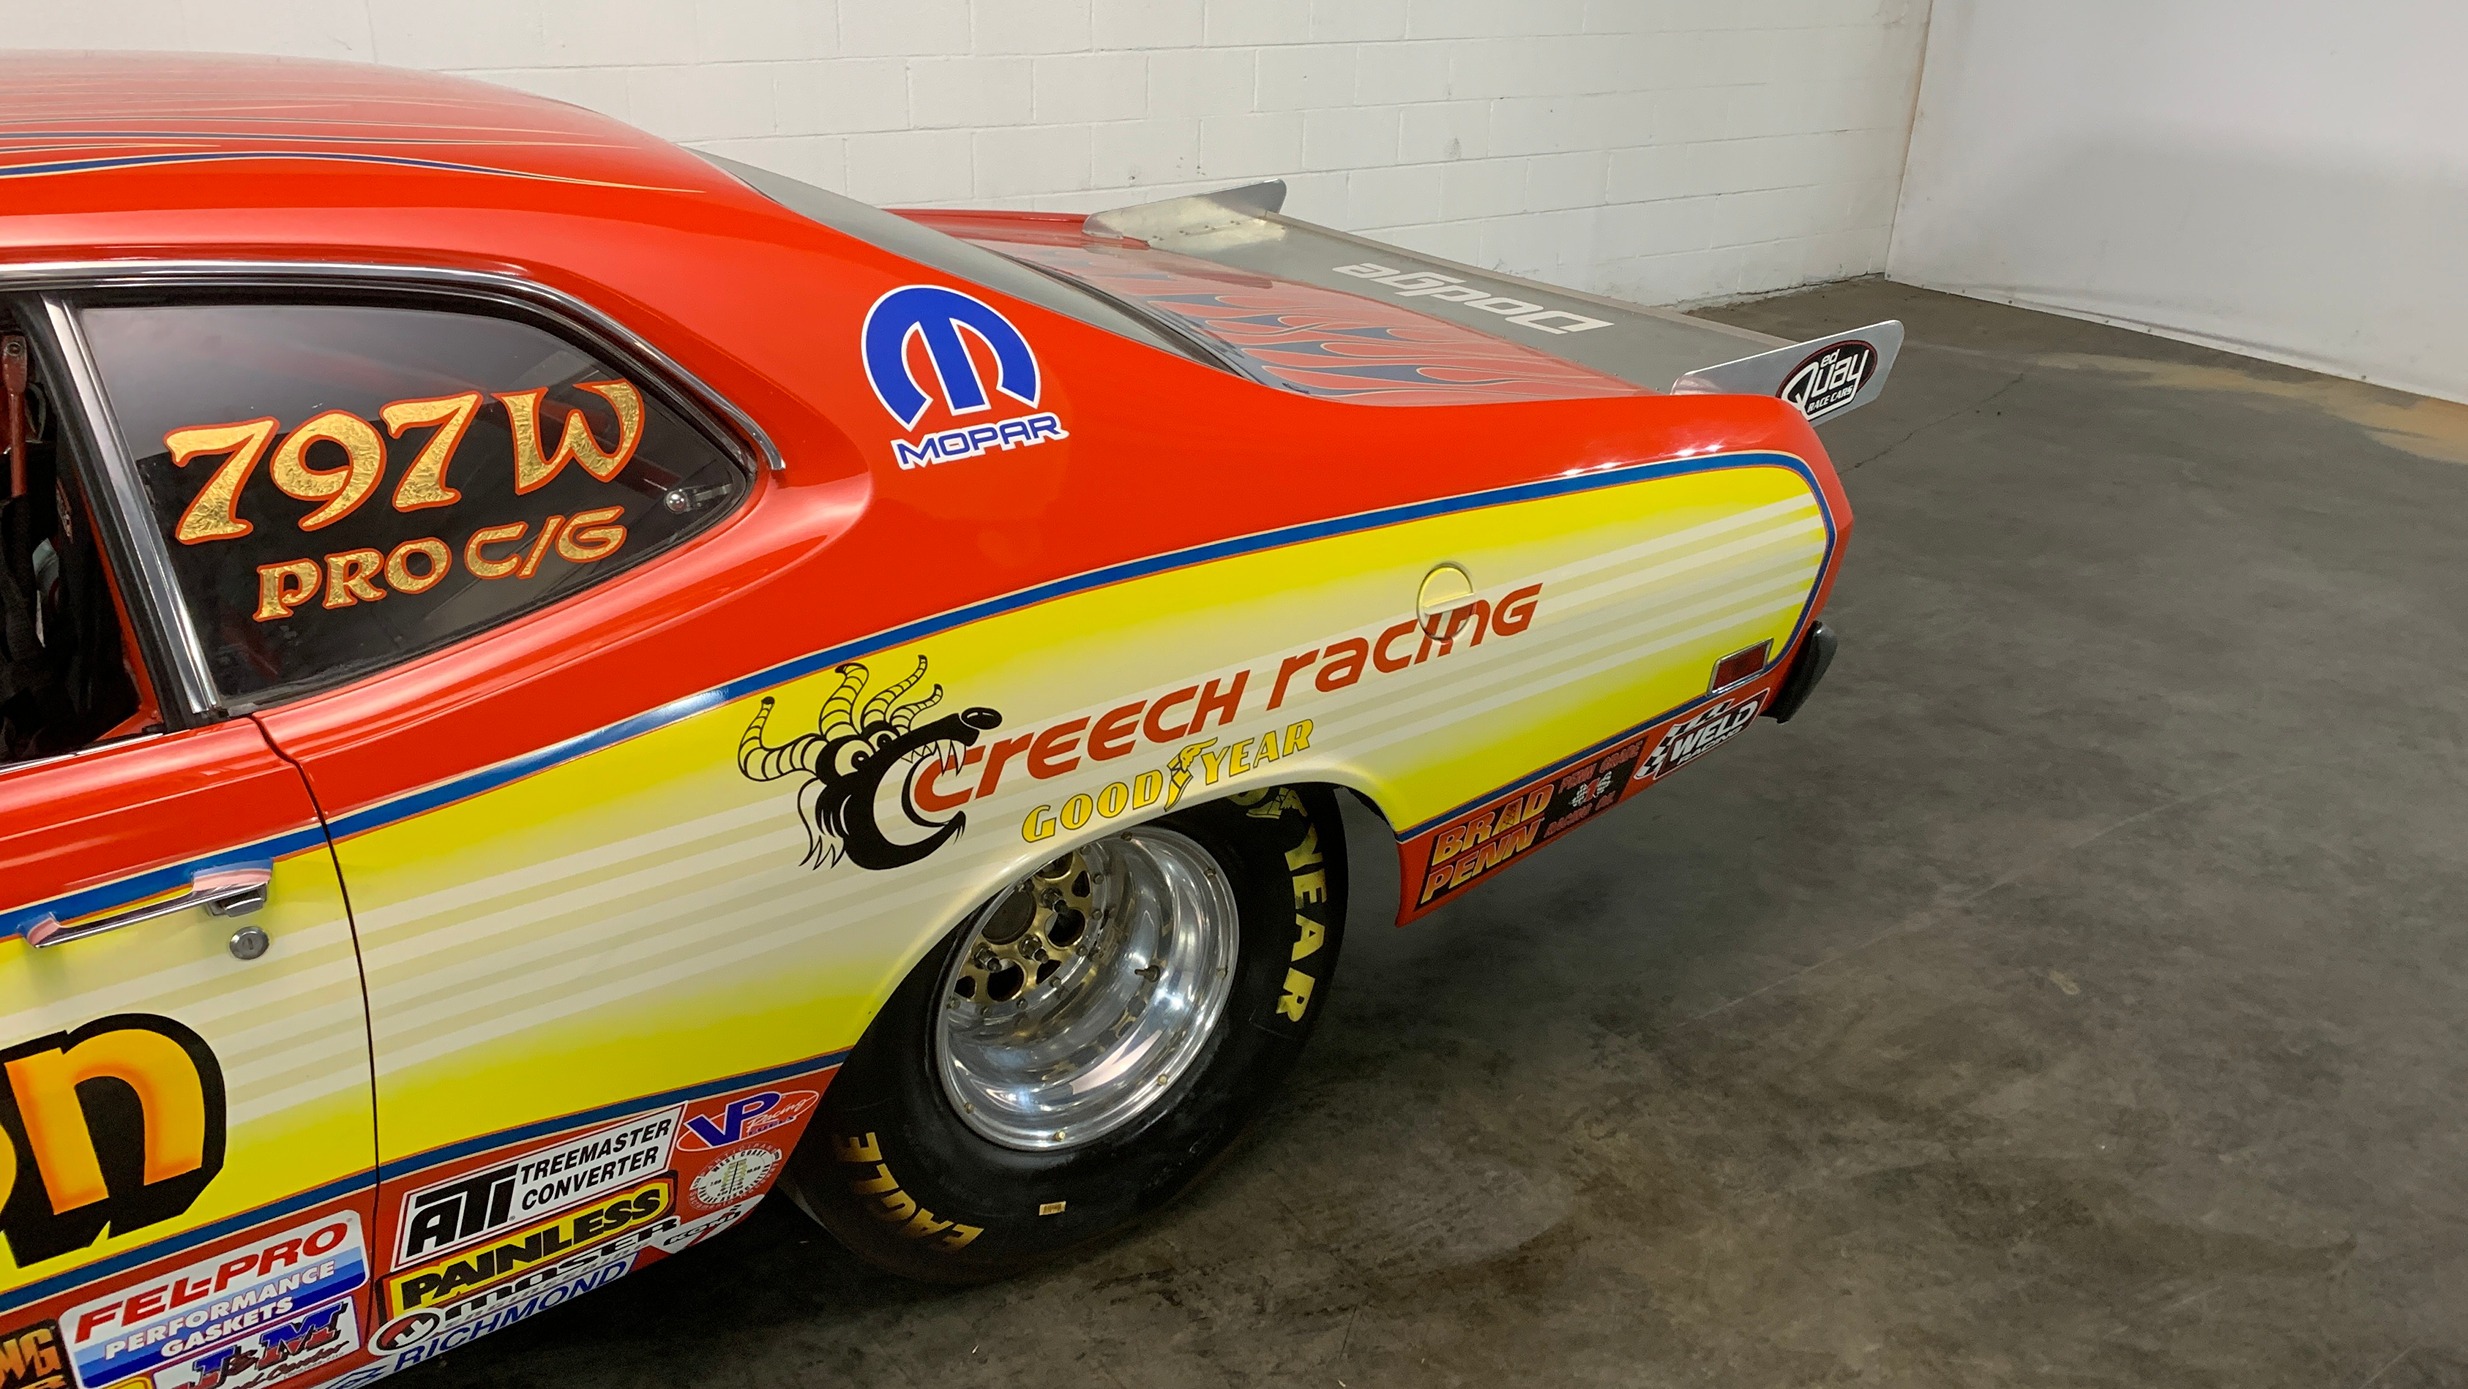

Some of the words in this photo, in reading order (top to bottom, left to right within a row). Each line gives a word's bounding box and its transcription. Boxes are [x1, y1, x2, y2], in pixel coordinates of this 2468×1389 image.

[1332, 262, 1615, 335] Dodge
[1807, 395, 1831, 413] RACE
[1830, 384, 1854, 403] CARS
[163, 390, 484, 546] 797
[492, 378, 646, 496] W
[892, 413, 1068, 469] MOPAR
[252, 535, 453, 622] PRO
[464, 505, 627, 581] C/G
[1670, 700, 1758, 762] WELD
[1420, 816, 1545, 905] PENN
[1431, 783, 1556, 867] BRAD
[520, 1117, 673, 1186] TREEMASTER
[683, 1090, 784, 1149] VP
[406, 1163, 520, 1259] ATI
[521, 1145, 660, 1211] CONVERTER
[74, 1220, 350, 1345] FEL-PRO
[401, 1186, 662, 1312] PAINLESS
[104, 1259, 336, 1362] PERFORMANCE
[160, 1295, 294, 1358] GASKETS
[393, 1259, 629, 1373] RICHMOND
